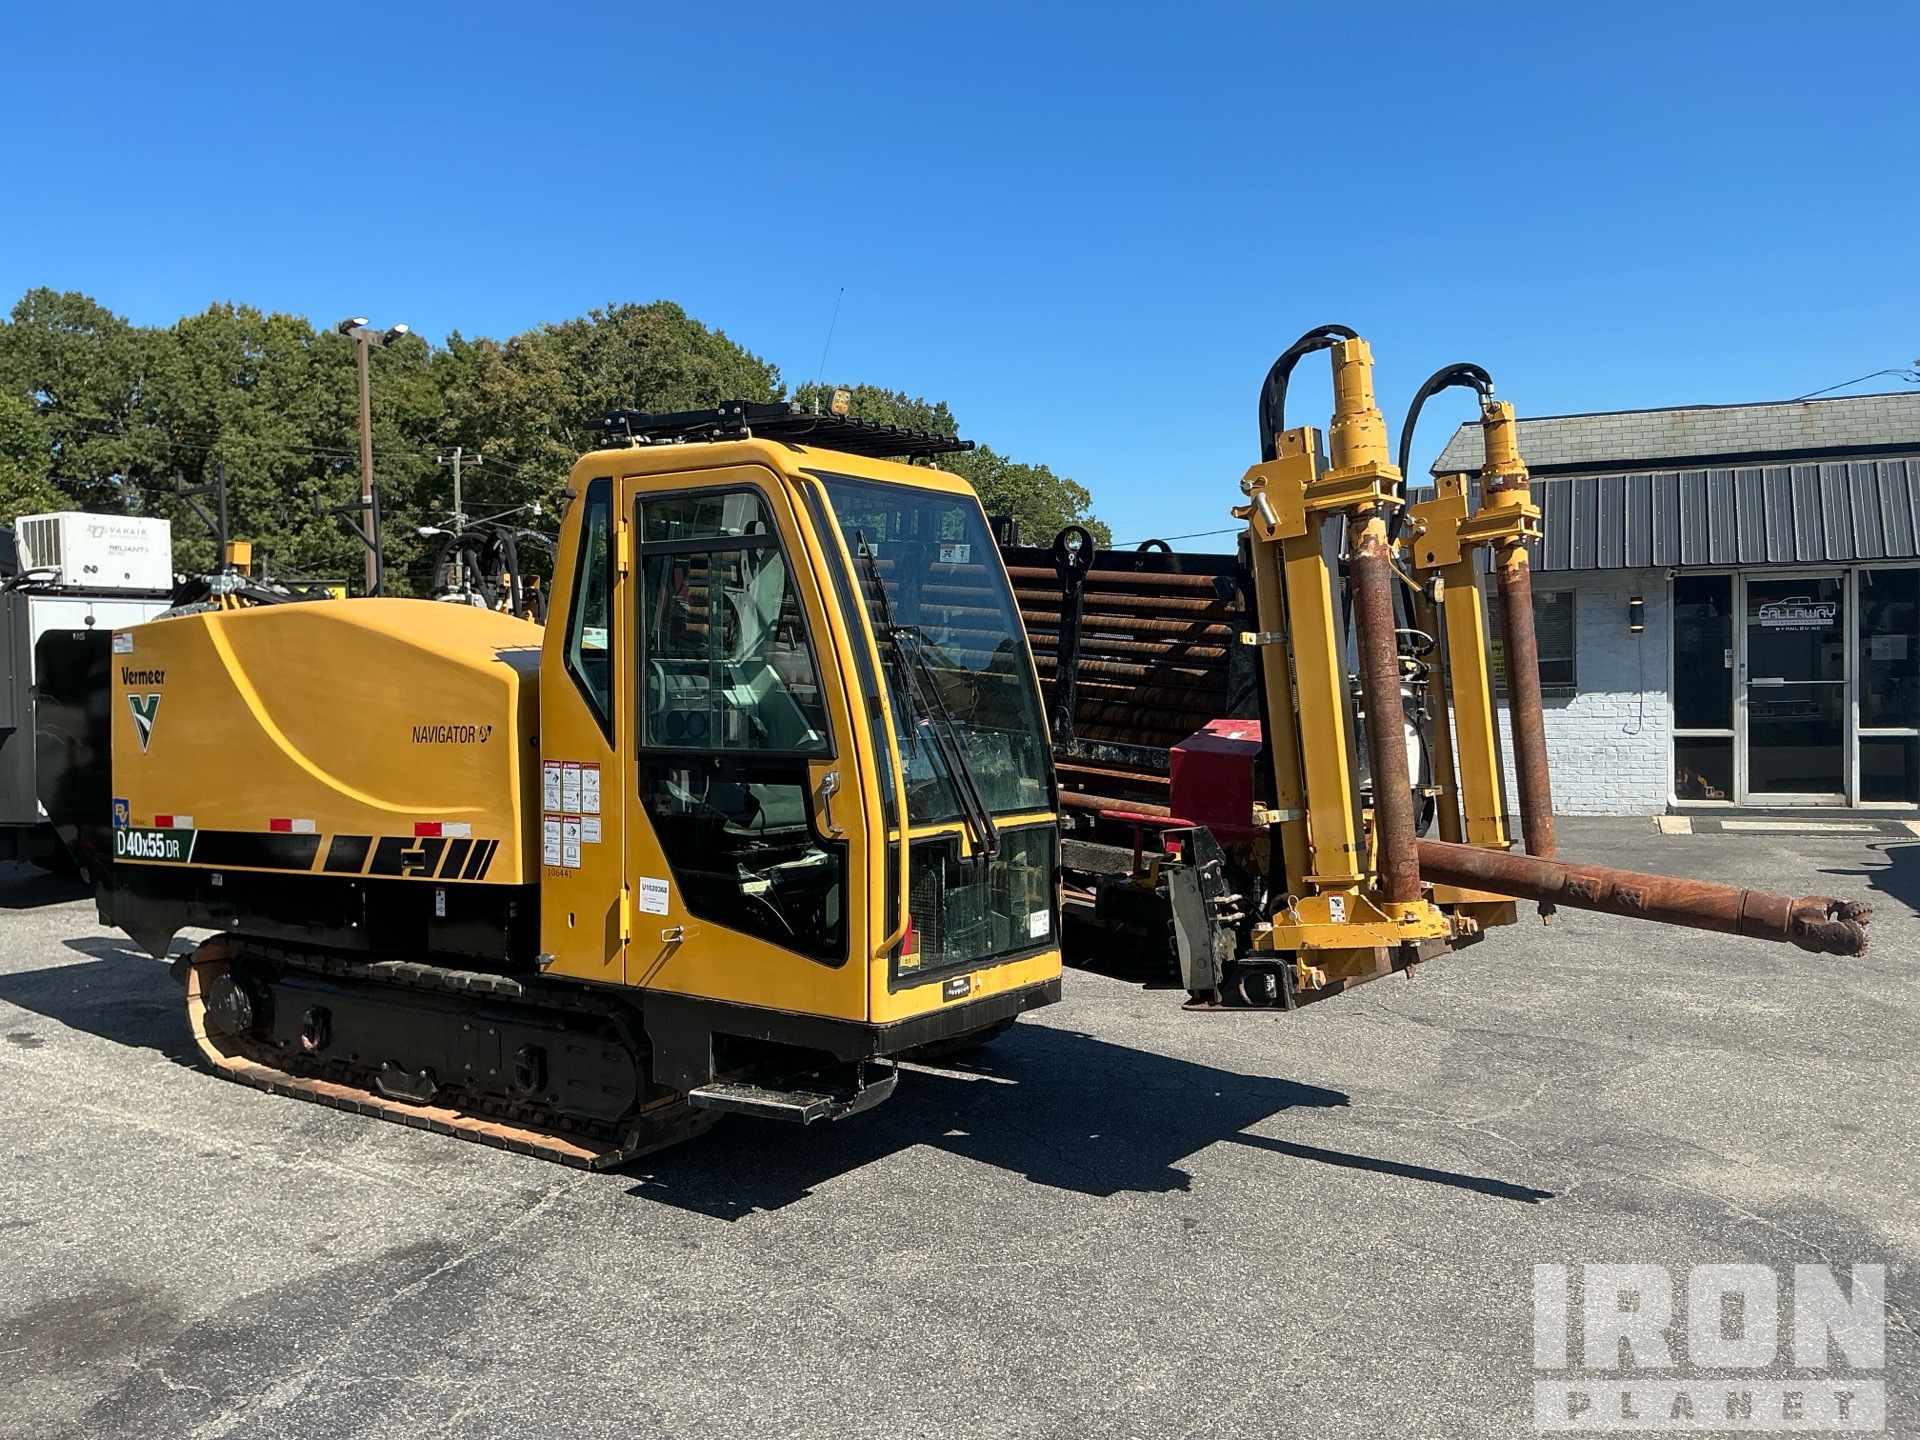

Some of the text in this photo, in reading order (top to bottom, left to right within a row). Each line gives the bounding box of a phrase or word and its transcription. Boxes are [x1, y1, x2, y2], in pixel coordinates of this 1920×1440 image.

[1759, 607, 1836, 619] CALLAWAY
[121, 667, 166, 685] Vermeer
[412, 725, 476, 744] NAVIGATOR
[547, 868, 573, 879] 106441
